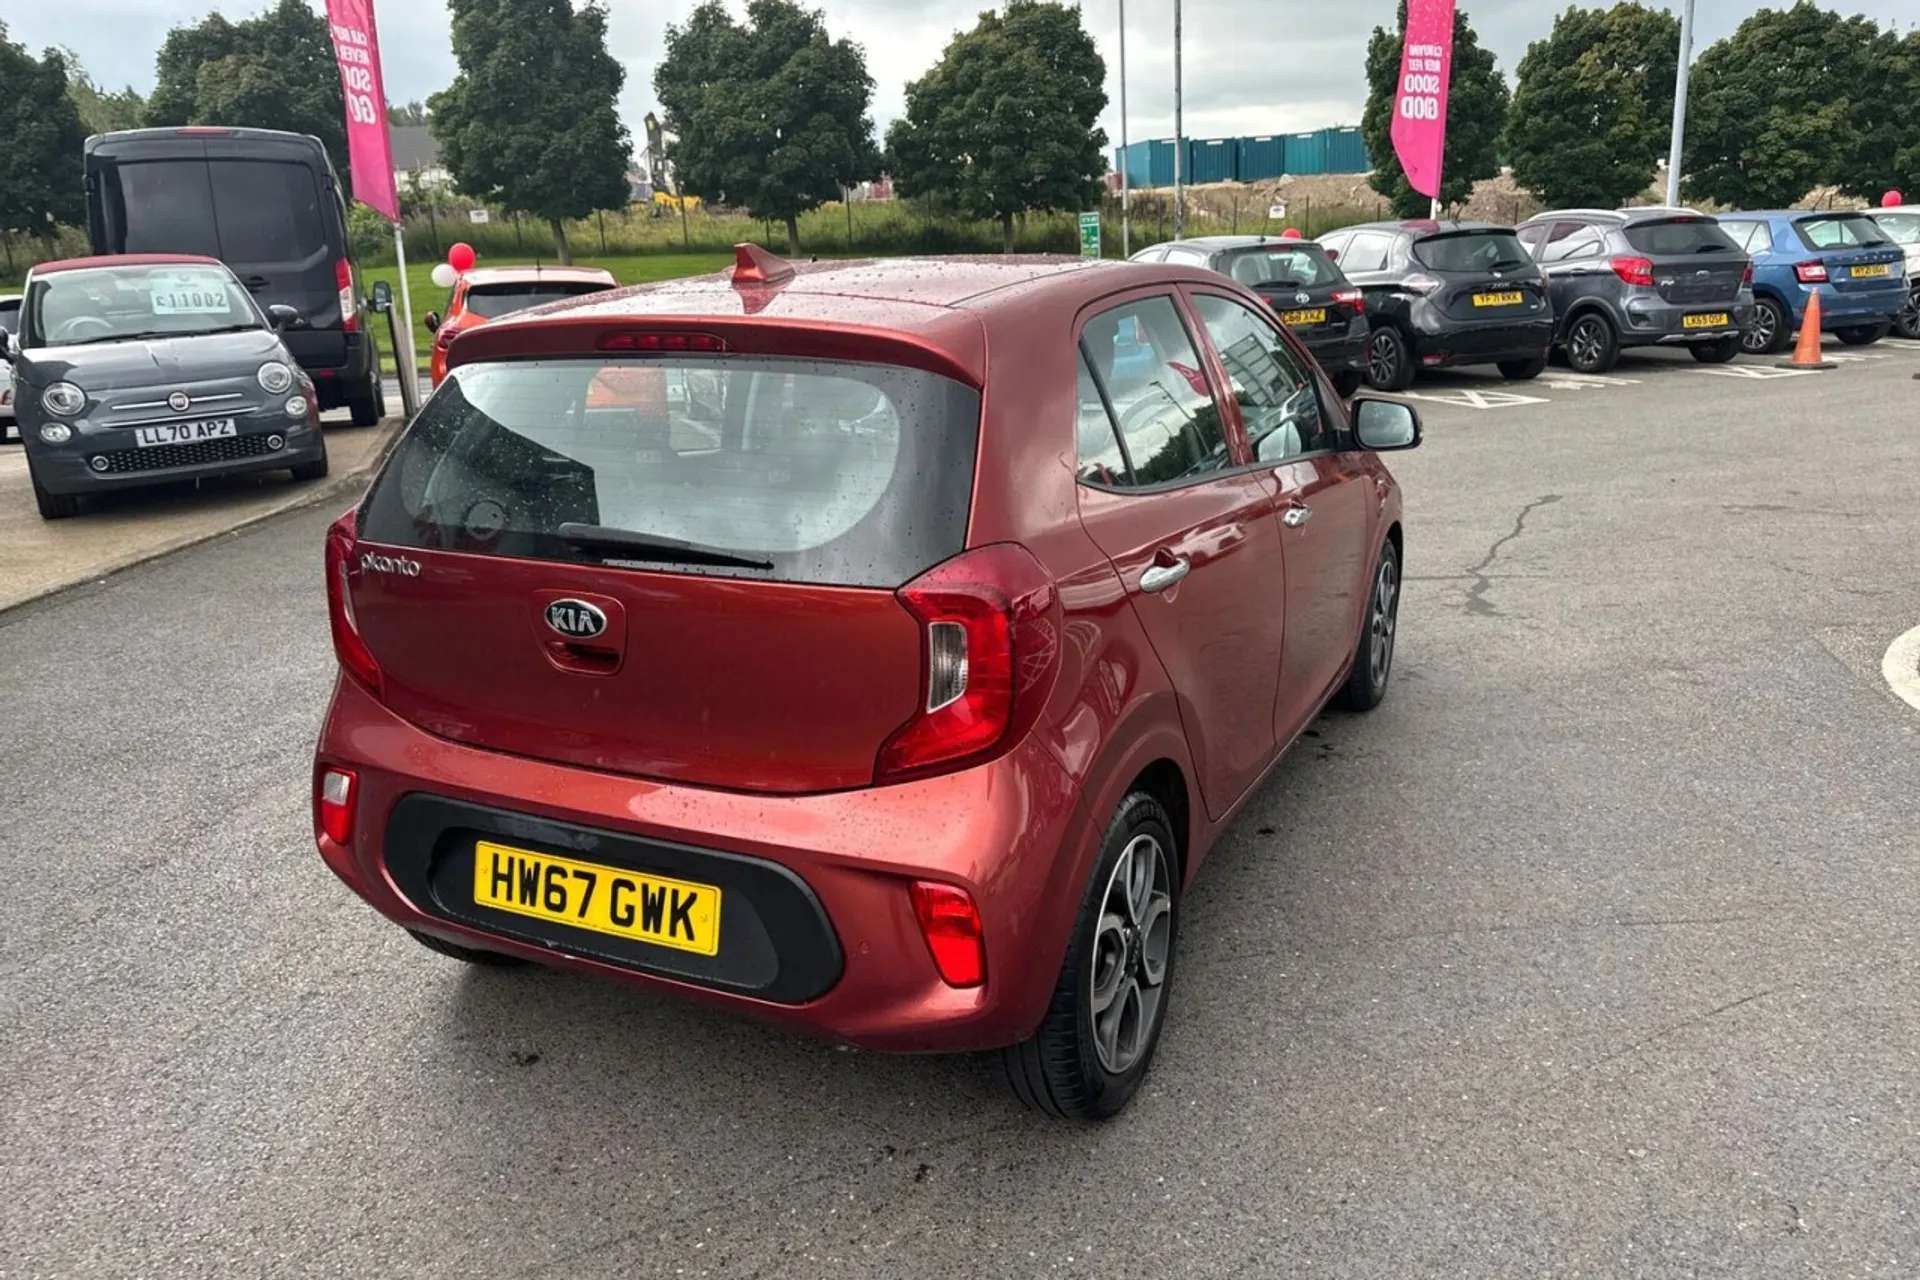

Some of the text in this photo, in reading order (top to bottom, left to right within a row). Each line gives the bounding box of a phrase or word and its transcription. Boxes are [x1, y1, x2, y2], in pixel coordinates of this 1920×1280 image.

[142, 420, 230, 444] LL70 APZ
[551, 606, 597, 633] KIA
[491, 852, 698, 942] HW67 GWK
